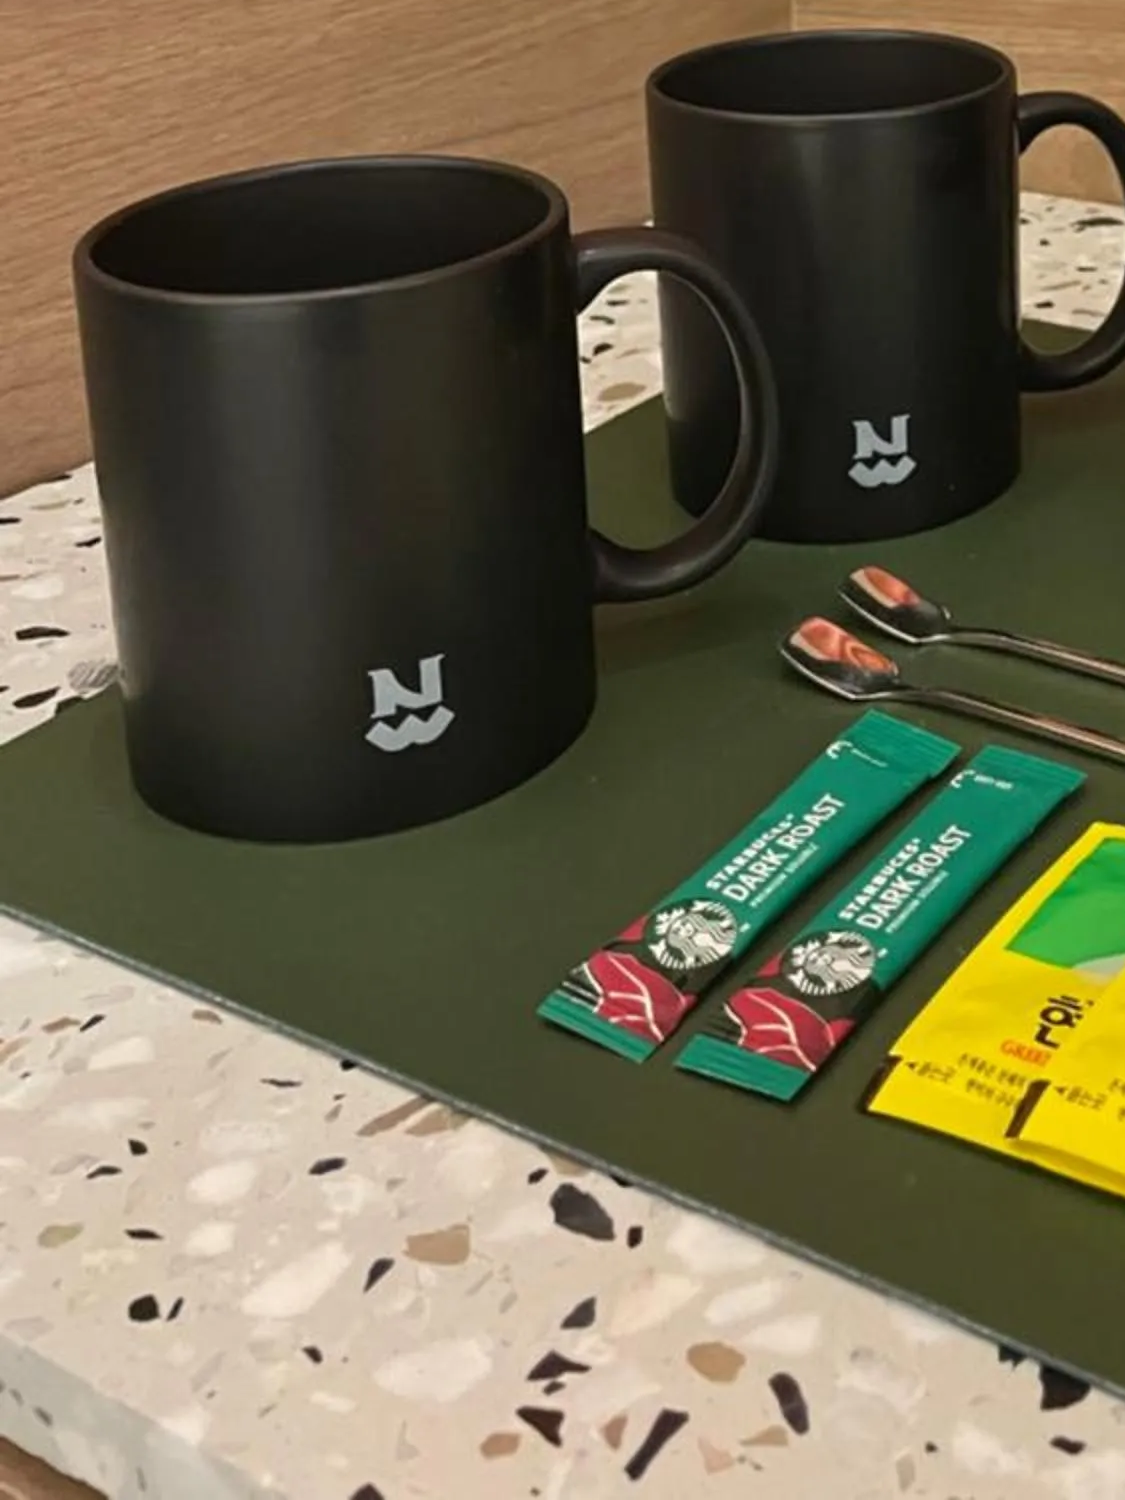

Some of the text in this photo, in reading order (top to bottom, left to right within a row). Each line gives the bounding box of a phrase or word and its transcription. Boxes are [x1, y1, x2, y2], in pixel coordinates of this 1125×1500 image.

[722, 793, 845, 902] DARK ROAST
[856, 875, 920, 930] DARK
[905, 824, 972, 878] ROAST
